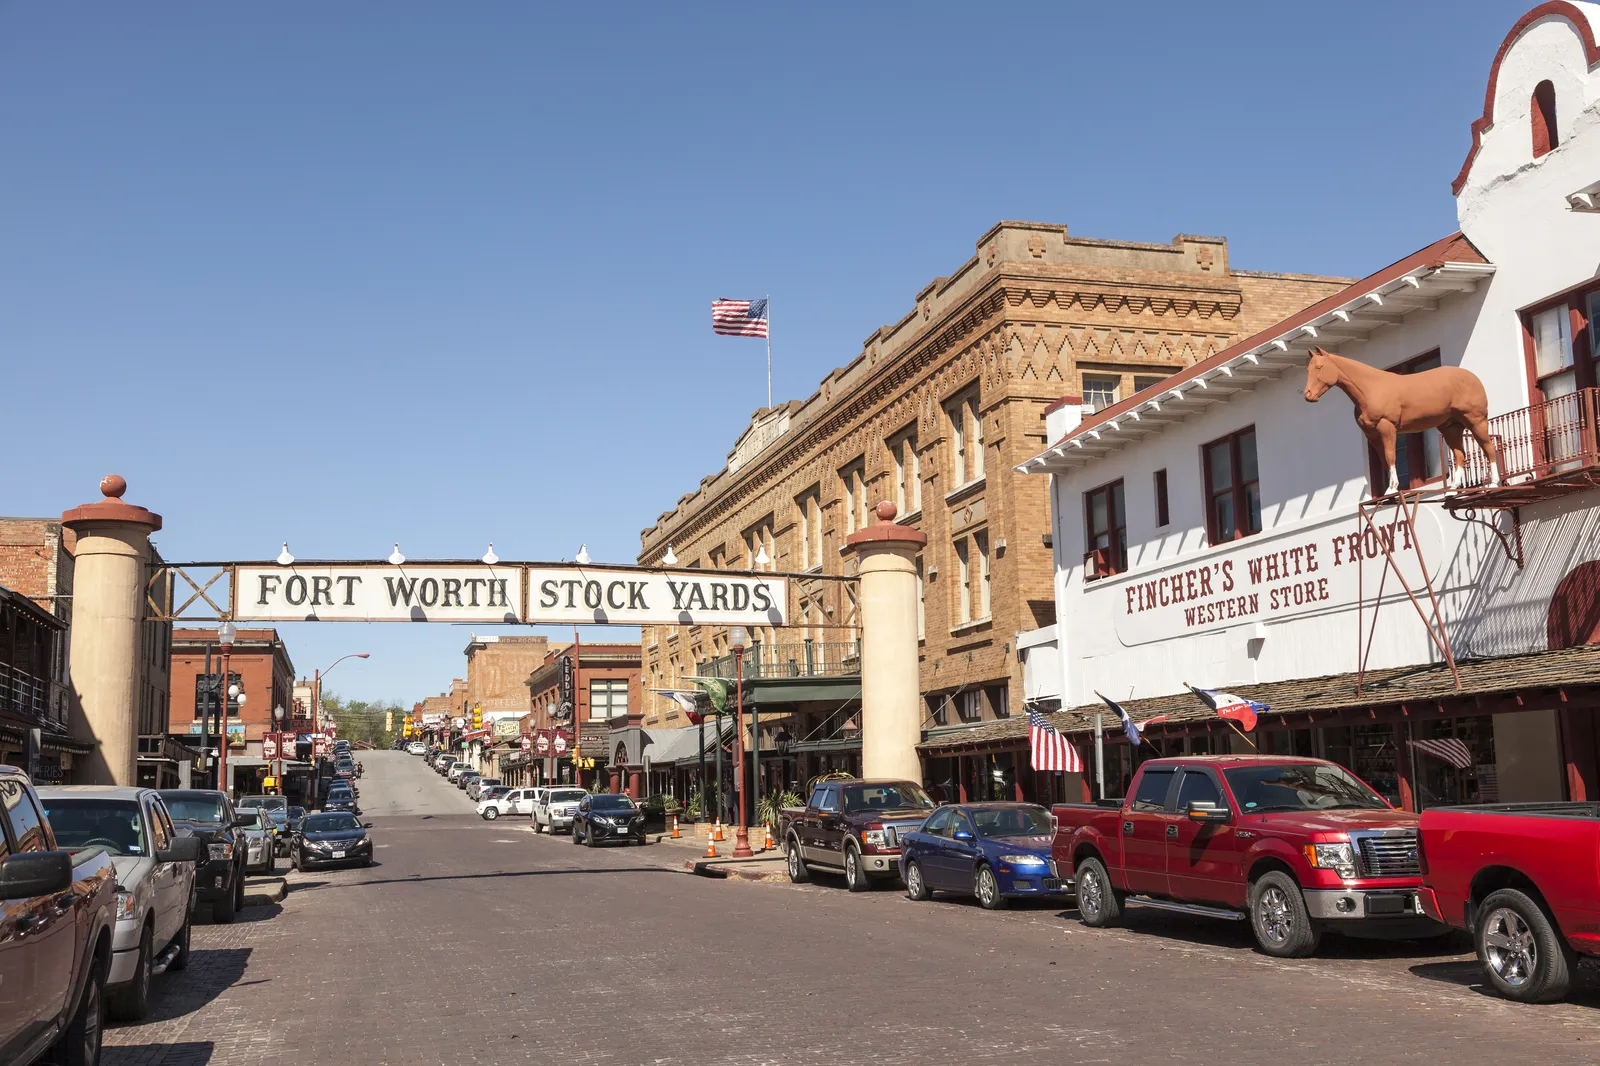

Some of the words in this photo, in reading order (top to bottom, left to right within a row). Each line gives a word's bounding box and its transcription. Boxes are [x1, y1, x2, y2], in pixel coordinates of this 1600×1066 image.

[1125, 559, 1234, 615] FINCHER'S
[1247, 543, 1319, 585] WHITE
[1332, 519, 1413, 567] FRONT
[256, 574, 363, 606] FORT
[383, 576, 508, 608] WORTH
[540, 579, 650, 610] STOCK
[666, 581, 771, 612] YARDS
[1185, 593, 1259, 627] WESTERN
[1270, 577, 1329, 611] STORE
